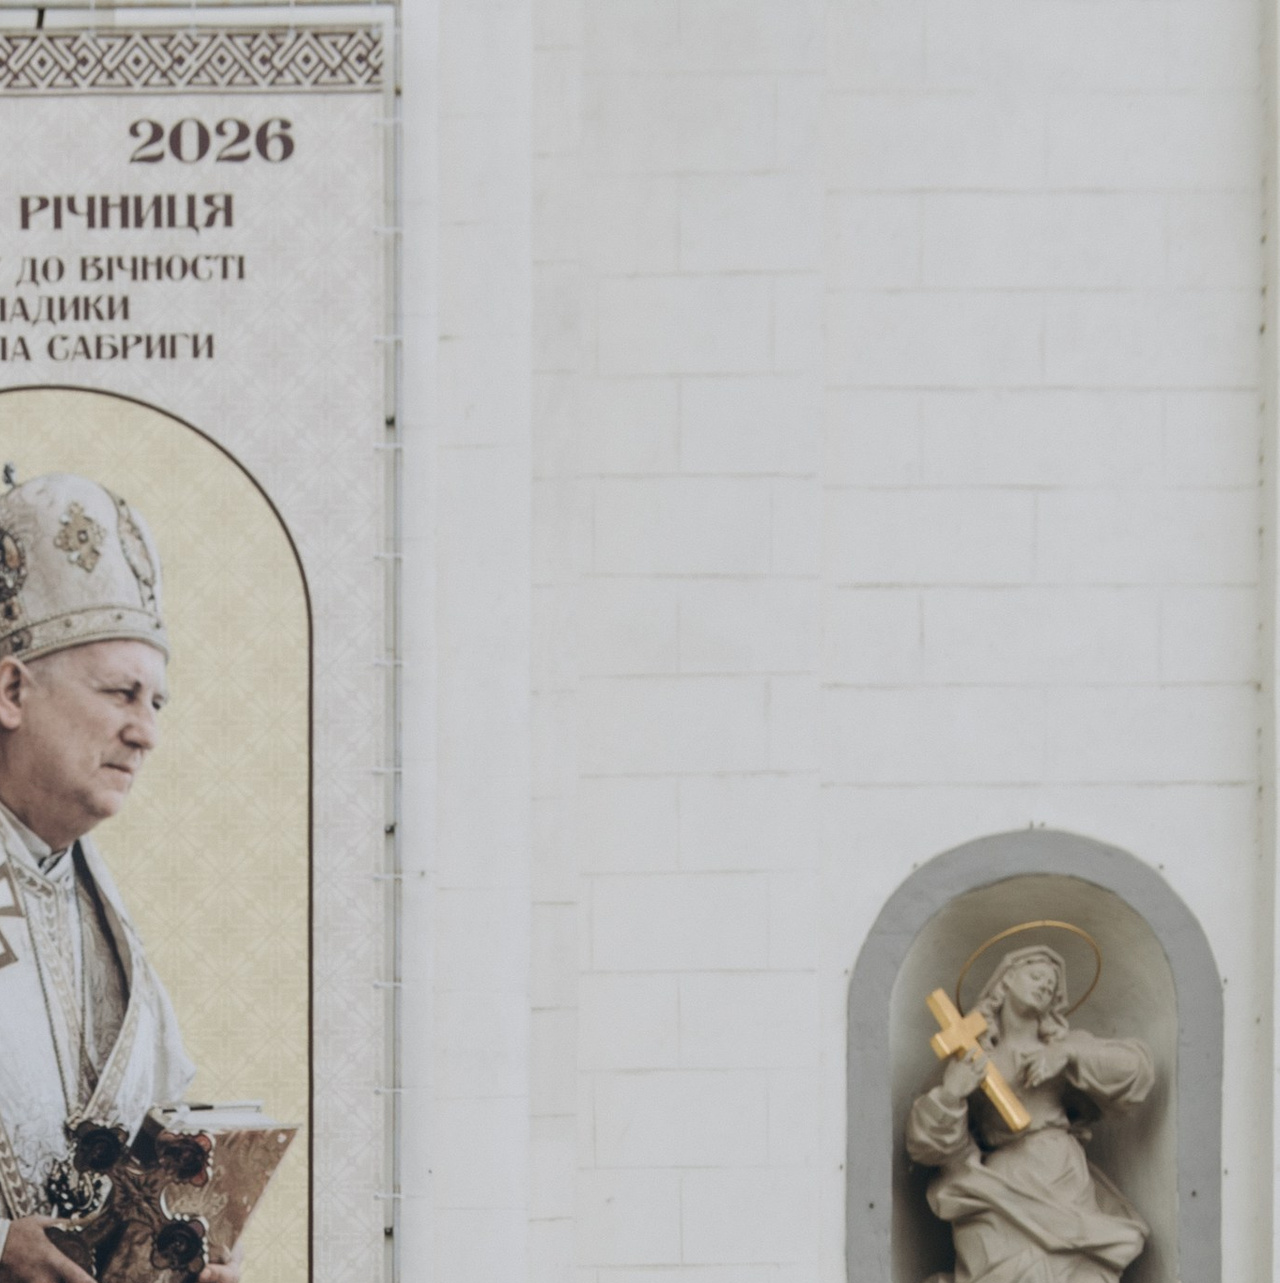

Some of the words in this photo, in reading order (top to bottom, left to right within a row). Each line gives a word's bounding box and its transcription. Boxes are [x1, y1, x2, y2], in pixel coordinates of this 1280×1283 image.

[128, 118, 295, 165] 2026
[19, 193, 234, 234] РІЧНИЦЯ
[15, 257, 66, 287] ДО
[79, 254, 245, 282] ВІЧНОСТІ
[46, 333, 215, 361] САБРИГИ
